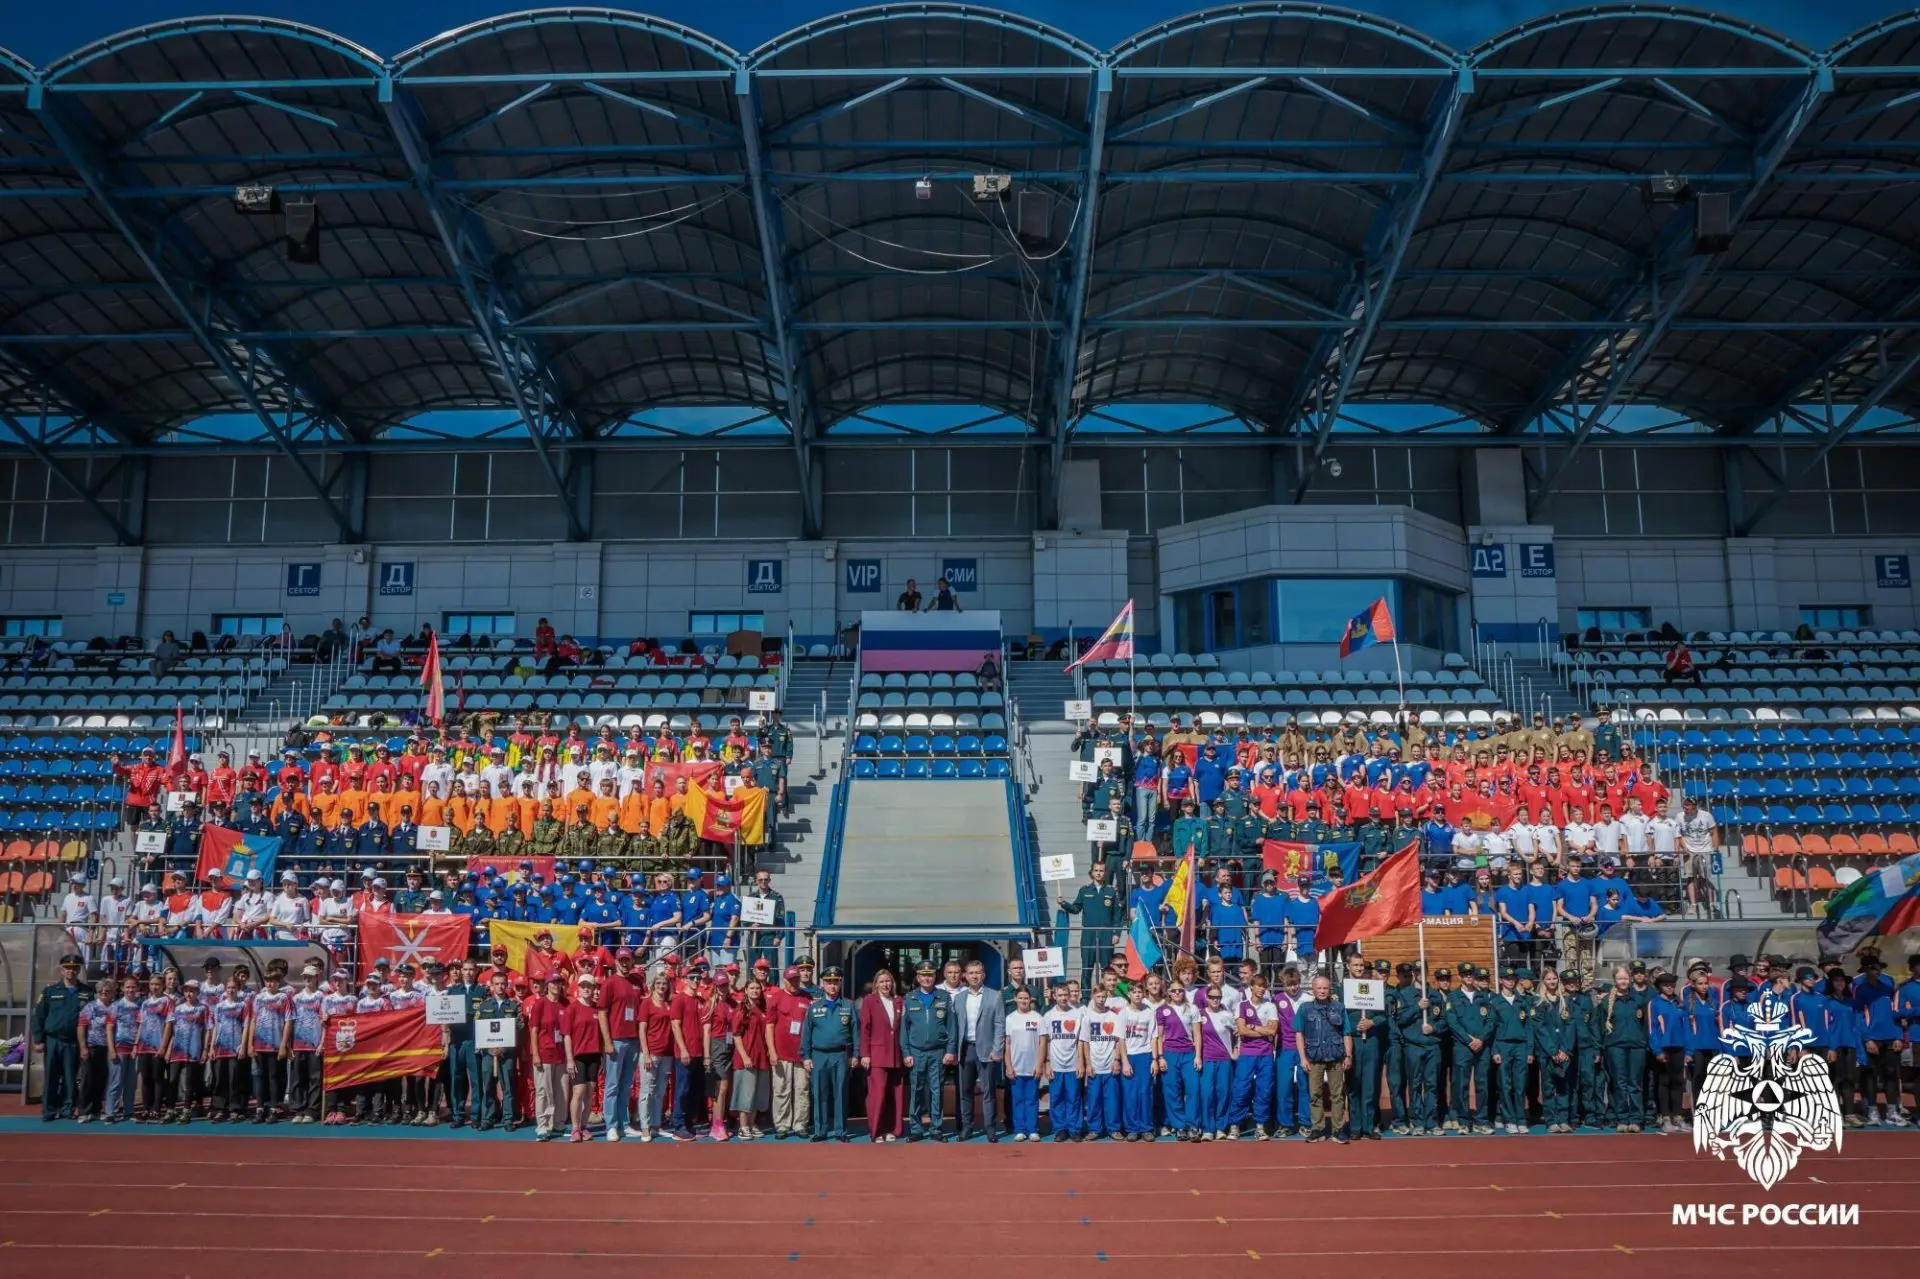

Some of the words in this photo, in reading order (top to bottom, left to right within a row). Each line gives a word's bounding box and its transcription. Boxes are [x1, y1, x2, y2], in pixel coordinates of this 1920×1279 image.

[1473, 549, 1504, 572] Д2
[1528, 546, 1546, 567] Е
[298, 565, 313, 587] Г
[386, 564, 406, 587] Д
[755, 562, 775, 585] Д
[848, 564, 879, 587] VIP
[944, 567, 976, 583] СМИ
[1522, 568, 1554, 577] СЕКТОР
[380, 585, 412, 594] СЕКТОР
[748, 583, 780, 592] СЕКТОР
[1878, 578, 1910, 587] СЕКТОР
[288, 586, 320, 595] СЕКТОР
[1051, 1020, 1063, 1034] Я
[1090, 1022, 1102, 1036] Я
